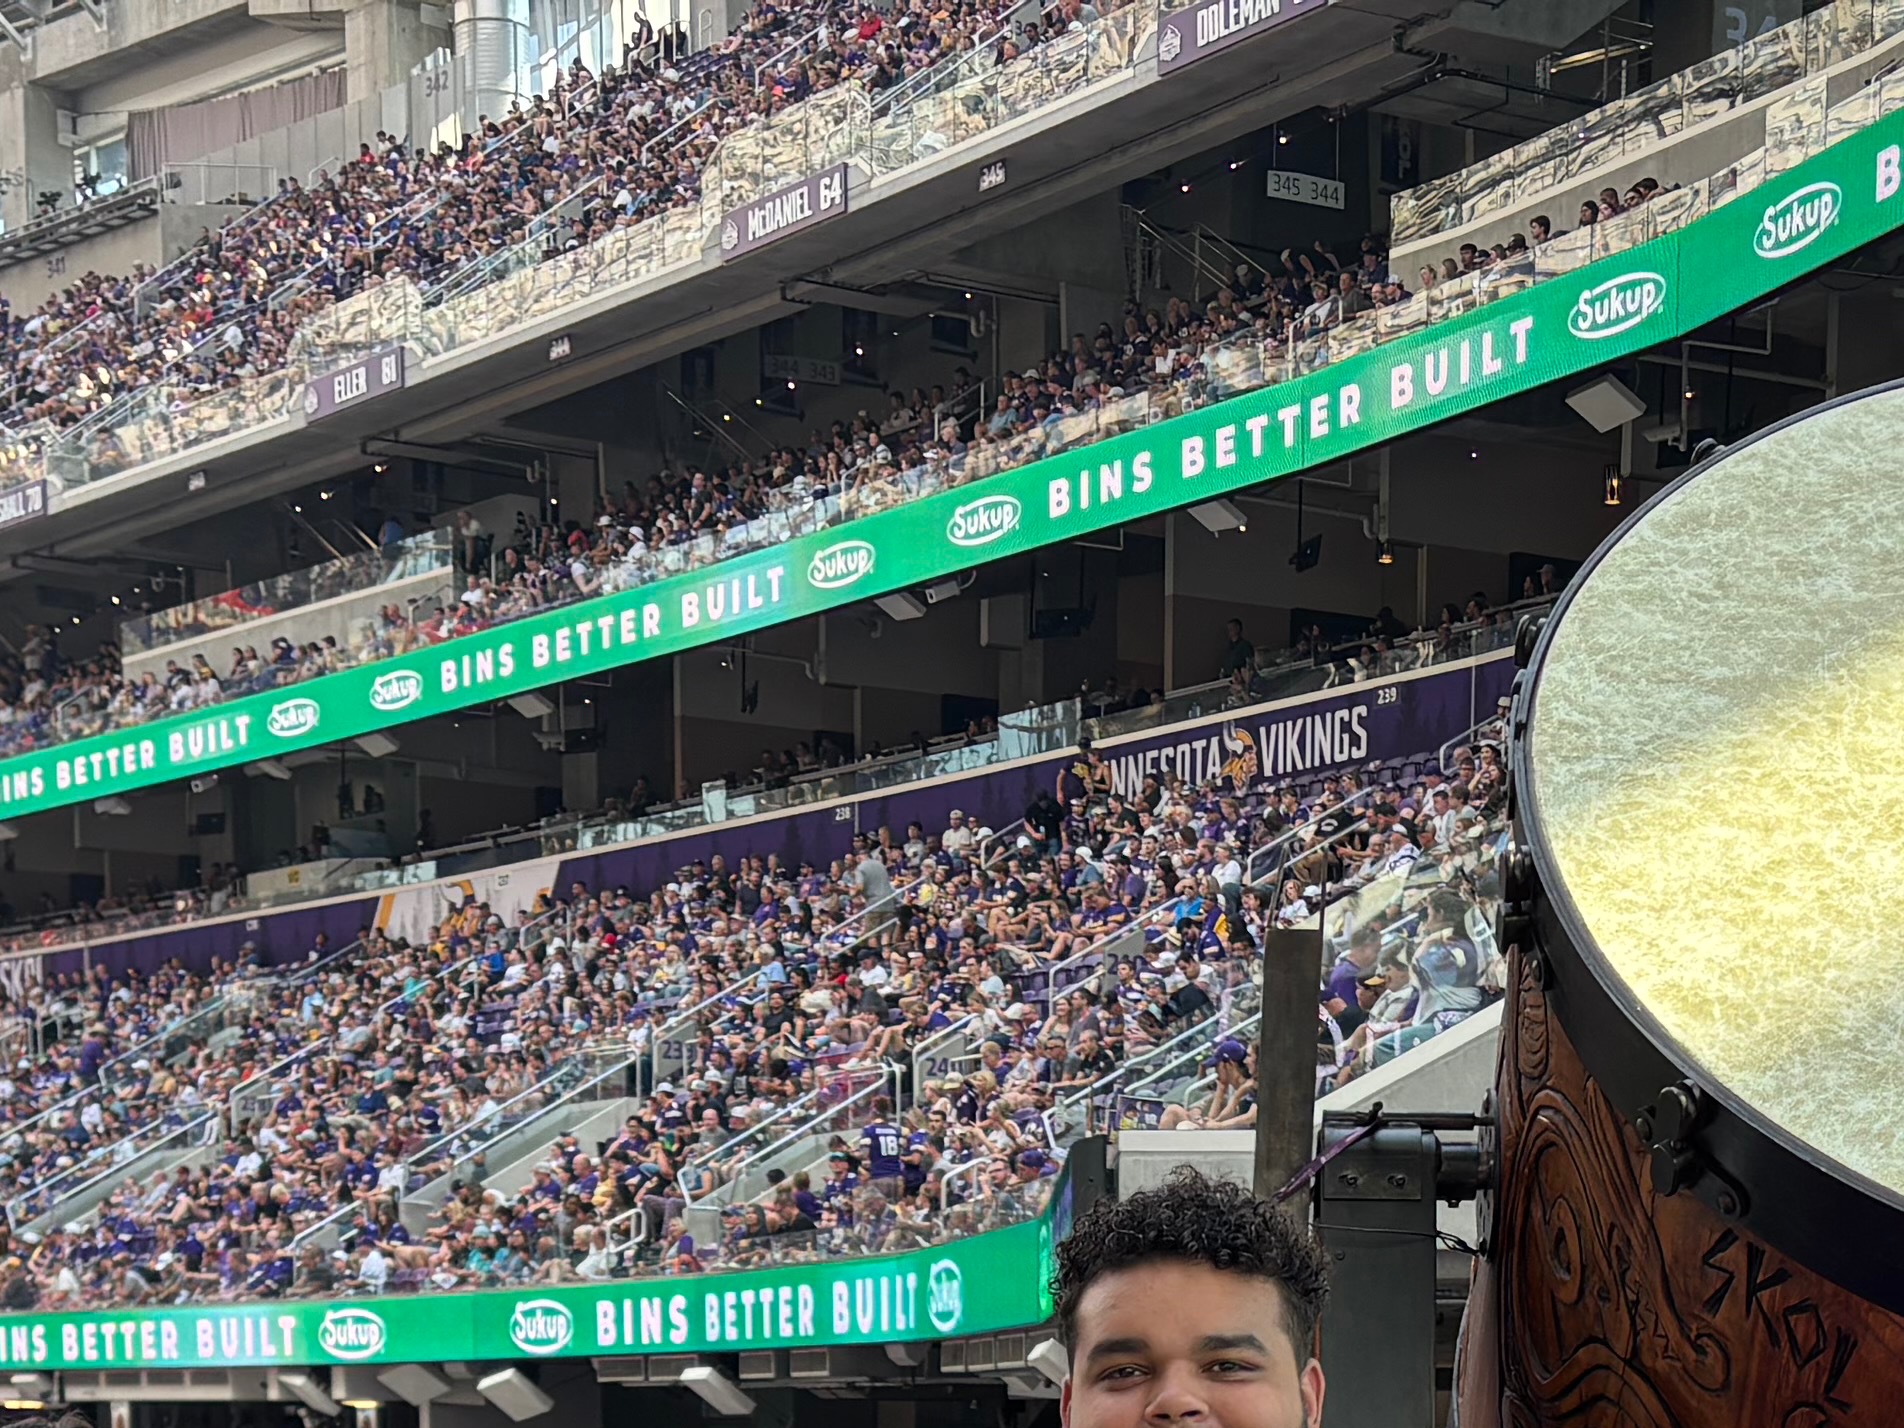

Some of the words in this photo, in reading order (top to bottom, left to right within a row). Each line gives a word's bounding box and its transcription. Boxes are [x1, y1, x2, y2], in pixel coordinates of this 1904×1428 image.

[425, 69, 449, 98] 342
[747, 184, 814, 242] McDANIEL
[818, 171, 842, 211] 64
[978, 161, 1008, 191] 345
[1273, 173, 1301, 196] 345
[1310, 184, 1340, 206] 344
[1758, 193, 1837, 247] Sukup
[333, 366, 368, 404] ELLER
[1049, 451, 1152, 518] BINS
[1182, 384, 1360, 478] BETTER
[1388, 316, 1532, 417] BUILT
[1576, 281, 1662, 330] Sukup
[441, 644, 514, 692] BINS
[533, 603, 661, 667] BETTER
[682, 565, 785, 630] BUILT
[812, 546, 872, 583] Sukup
[953, 500, 1017, 539] Sukup
[1376, 687, 1398, 705] 239
[57, 741, 154, 789] BETTER
[170, 715, 250, 763] BUILT
[1259, 704, 1369, 778] VIKINGS
[63, 1320, 179, 1361] BETTER
[196, 1314, 297, 1359] BUILT
[322, 1312, 383, 1355] Sukup
[515, 1303, 570, 1346] Sukup
[597, 1295, 688, 1346] BINS
[706, 1285, 813, 1341] BETTER
[833, 1274, 916, 1334] BUILT
[1701, 1227, 1859, 1414] SKOL
